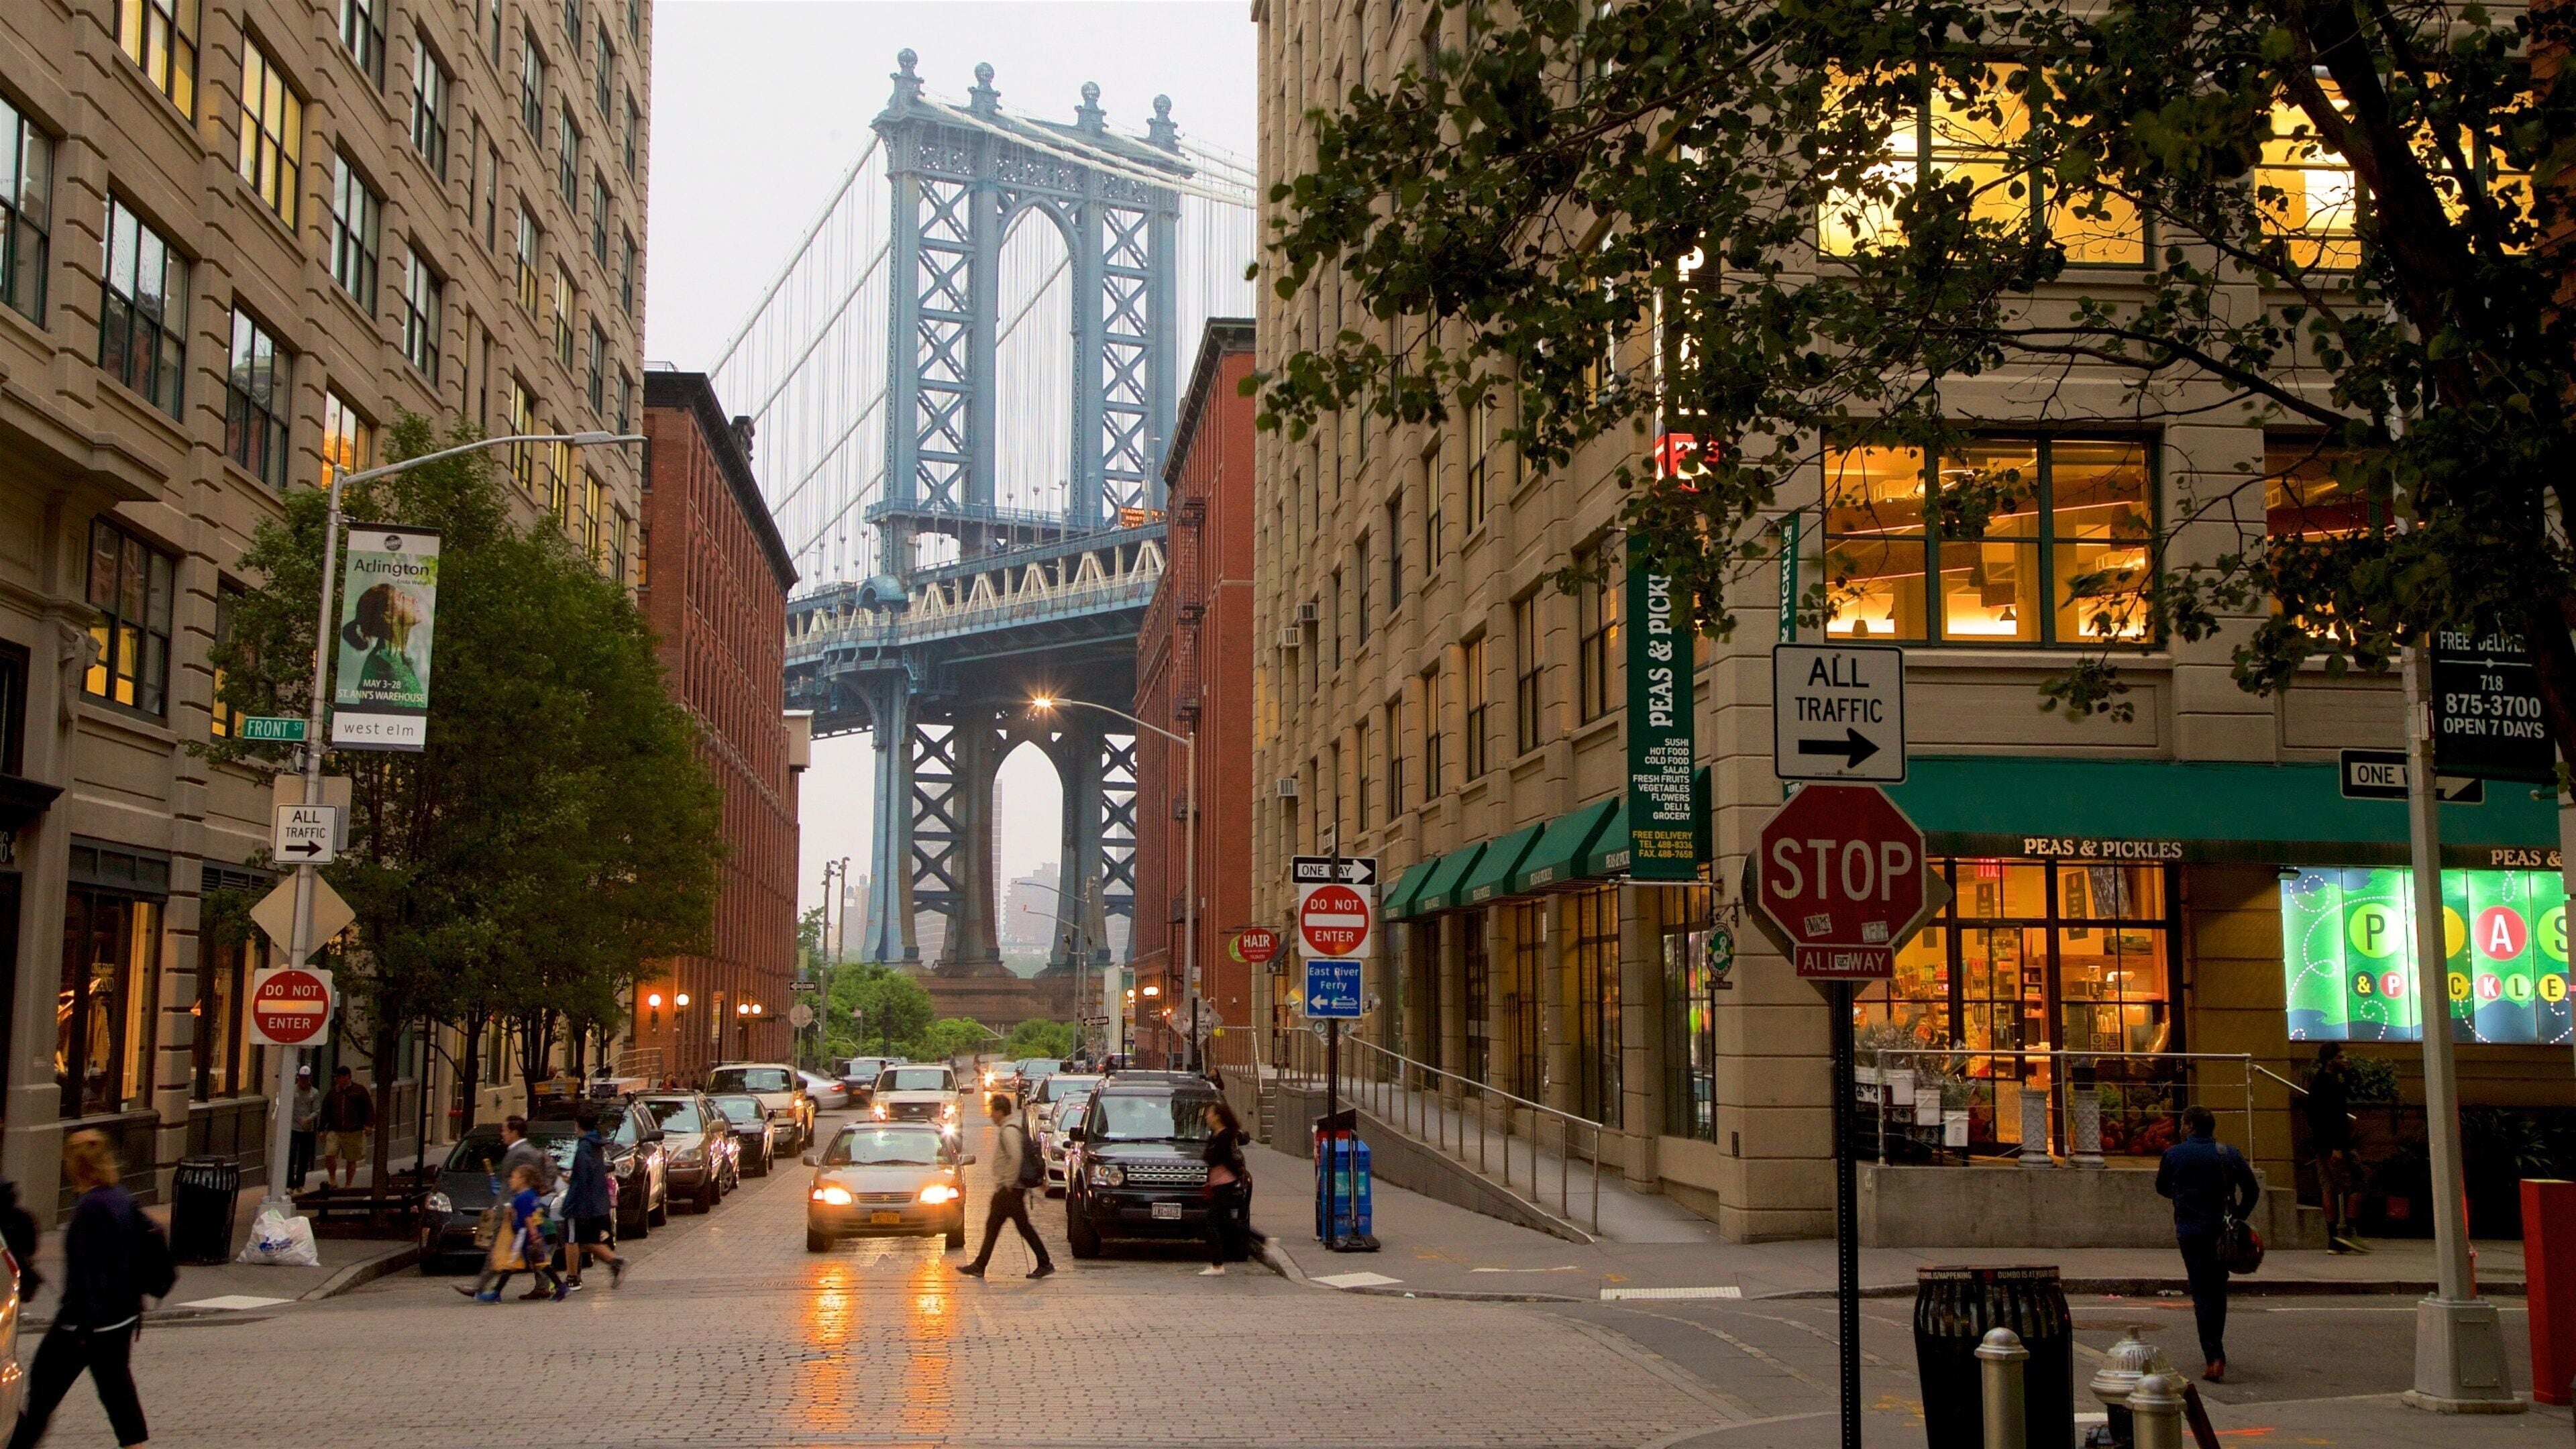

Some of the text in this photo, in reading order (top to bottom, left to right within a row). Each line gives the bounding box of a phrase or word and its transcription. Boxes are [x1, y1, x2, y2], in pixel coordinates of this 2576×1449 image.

[354, 559, 429, 576] Arlington
[2440, 631, 2471, 650] FREE
[1648, 641, 1672, 661] &
[1807, 657, 1869, 688] ALL
[363, 680, 381, 688] MAY
[2480, 675, 2504, 691] 718
[338, 690, 425, 702] ST. ANN'S WAREHOUSE
[1648, 667, 1673, 727] PEAS
[1795, 697, 1882, 722] TRAFFIC
[2446, 693, 2541, 718] 875-3700
[248, 720, 303, 737] FRONT ST
[345, 723, 414, 736] west elm
[2444, 718, 2544, 739] OPEN 7 DAYS
[1664, 738, 1688, 746] SUSHI
[1650, 747, 1689, 756] HOT FOOD
[1645, 756, 1689, 765] COLD FOOD
[1663, 766, 1689, 774] SALAD
[2357, 765, 2396, 784] ONE
[1633, 774, 1690, 783] FRESH FRUITS
[1638, 784, 1690, 792] VEGETABLES
[1652, 794, 1690, 802] FLOWERS
[1664, 802, 1690, 811] DELI &
[292, 810, 321, 823] ALL
[1653, 812, 1690, 820] GROCERY
[286, 827, 326, 839] TRAFFIC
[1654, 831, 1693, 840] DELIVERY
[1639, 840, 1693, 849] TEL. 488-8336
[2024, 838, 2183, 858] PEAS & PICKLES
[1639, 849, 1693, 859] FAX. 488-7658
[2491, 849, 2563, 867] PEAS &
[1302, 865, 1351, 876] ONE AY
[1772, 837, 1913, 901] STOP
[1311, 899, 1358, 910] DO NOT
[1315, 930, 1354, 943] ENTER
[2365, 914, 2568, 953] PAS
[1243, 934, 1270, 947] HAIR
[1803, 952, 1836, 971] ALL
[1848, 952, 1886, 971] WAY
[1309, 967, 1358, 977] East River
[266, 985, 319, 996] DO NOT
[1320, 981, 1347, 991] Ferry
[2357, 976, 2371, 994] &
[268, 1018, 311, 1028] ENTER
[1997, 1271, 2021, 1279] DUMBO
[2021, 1270, 2027, 1279] IS
[2028, 1270, 2035, 1278] AT
